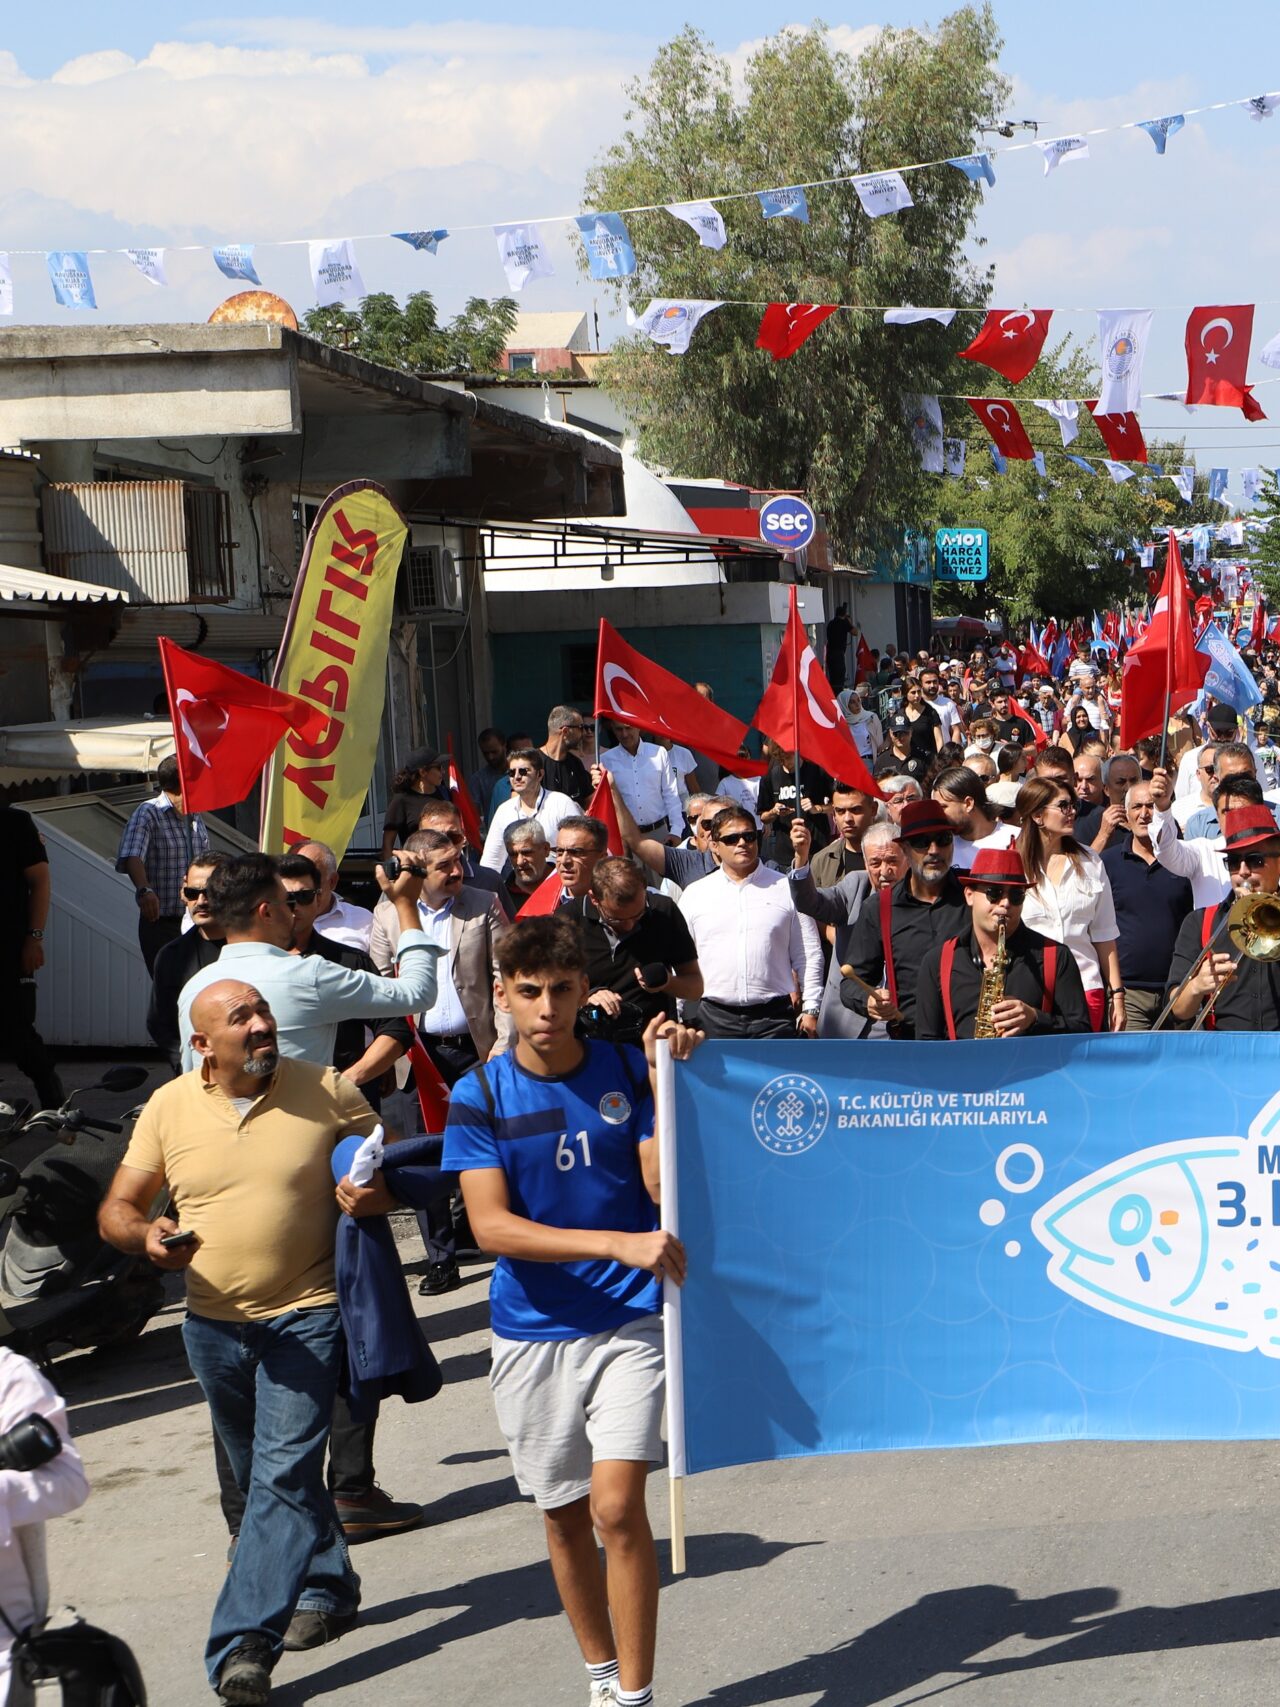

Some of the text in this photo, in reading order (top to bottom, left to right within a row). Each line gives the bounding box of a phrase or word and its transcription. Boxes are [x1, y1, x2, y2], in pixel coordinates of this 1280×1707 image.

[766, 513, 808, 533] seç
[942, 547, 982, 556] HARCA
[942, 557, 982, 566] HARCA
[839, 1090, 1025, 1110] T.C. KÜLTÜR VE TURİZM
[838, 1110, 1048, 1129] BAKANLIĞI KATKILARIYLA
[555, 1130, 592, 1172] 61
